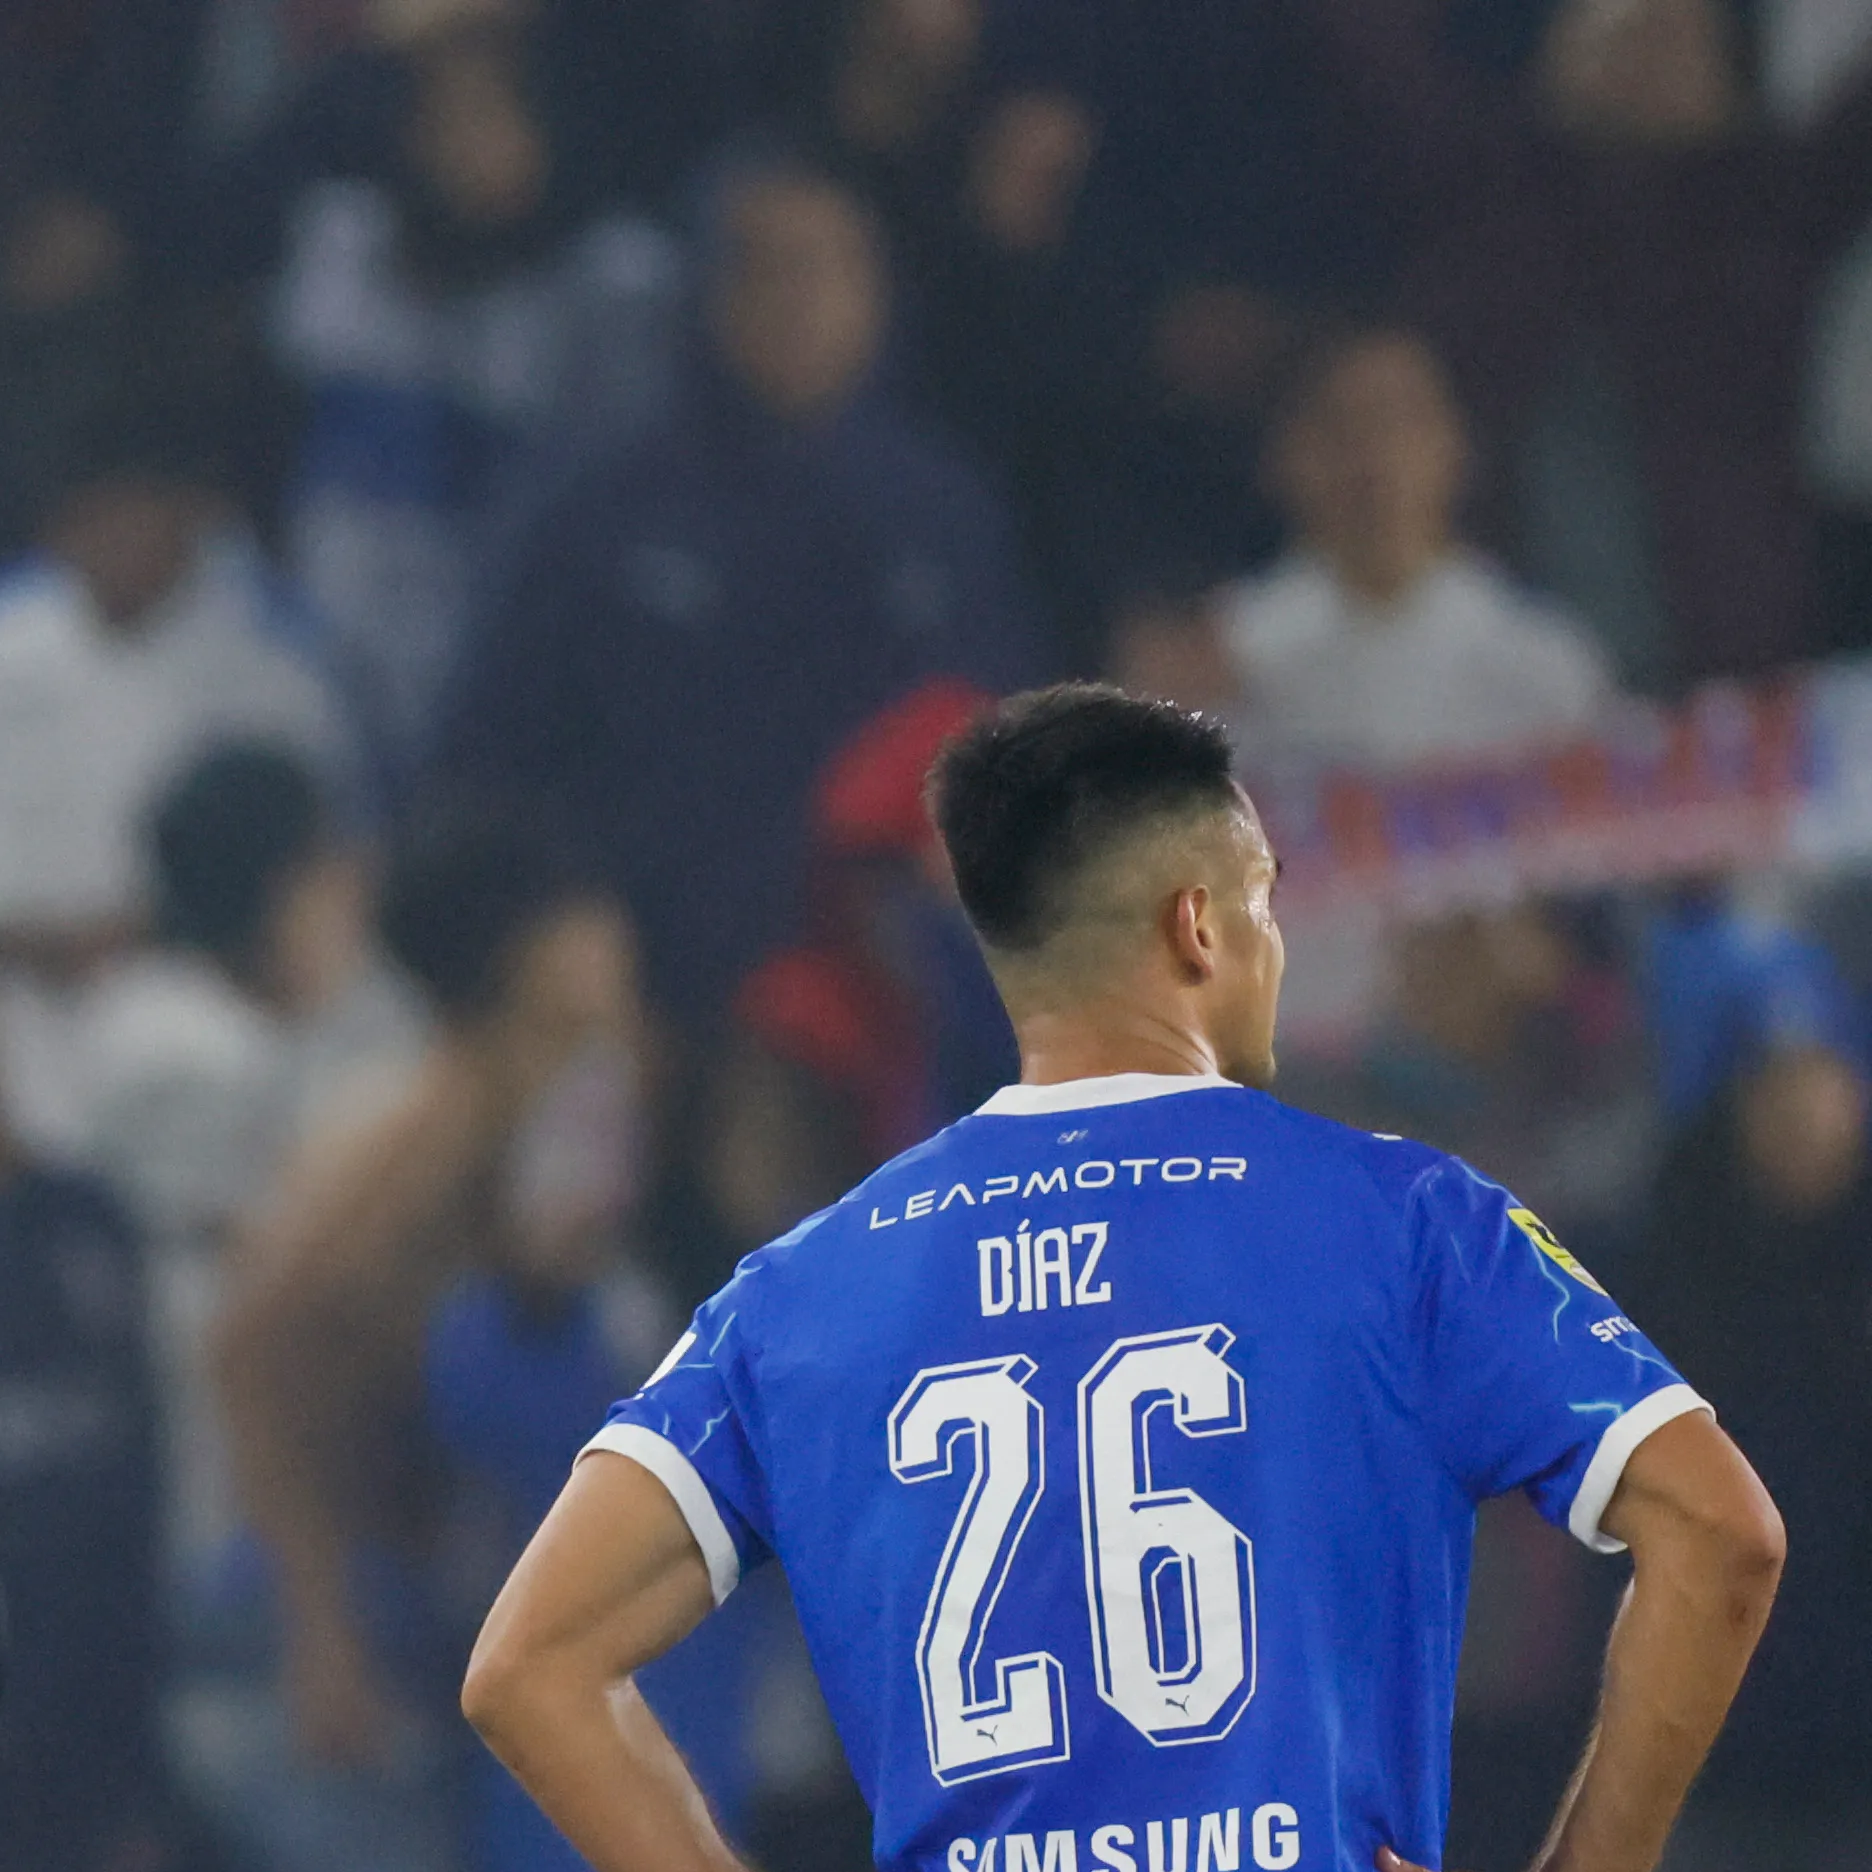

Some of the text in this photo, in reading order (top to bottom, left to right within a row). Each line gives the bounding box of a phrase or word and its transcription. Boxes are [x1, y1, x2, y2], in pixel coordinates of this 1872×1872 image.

[868, 1156, 1248, 1230] LEAPMOTOR
[976, 1218, 1112, 1317] DÍAZ
[886, 1321, 1258, 1788] 26
